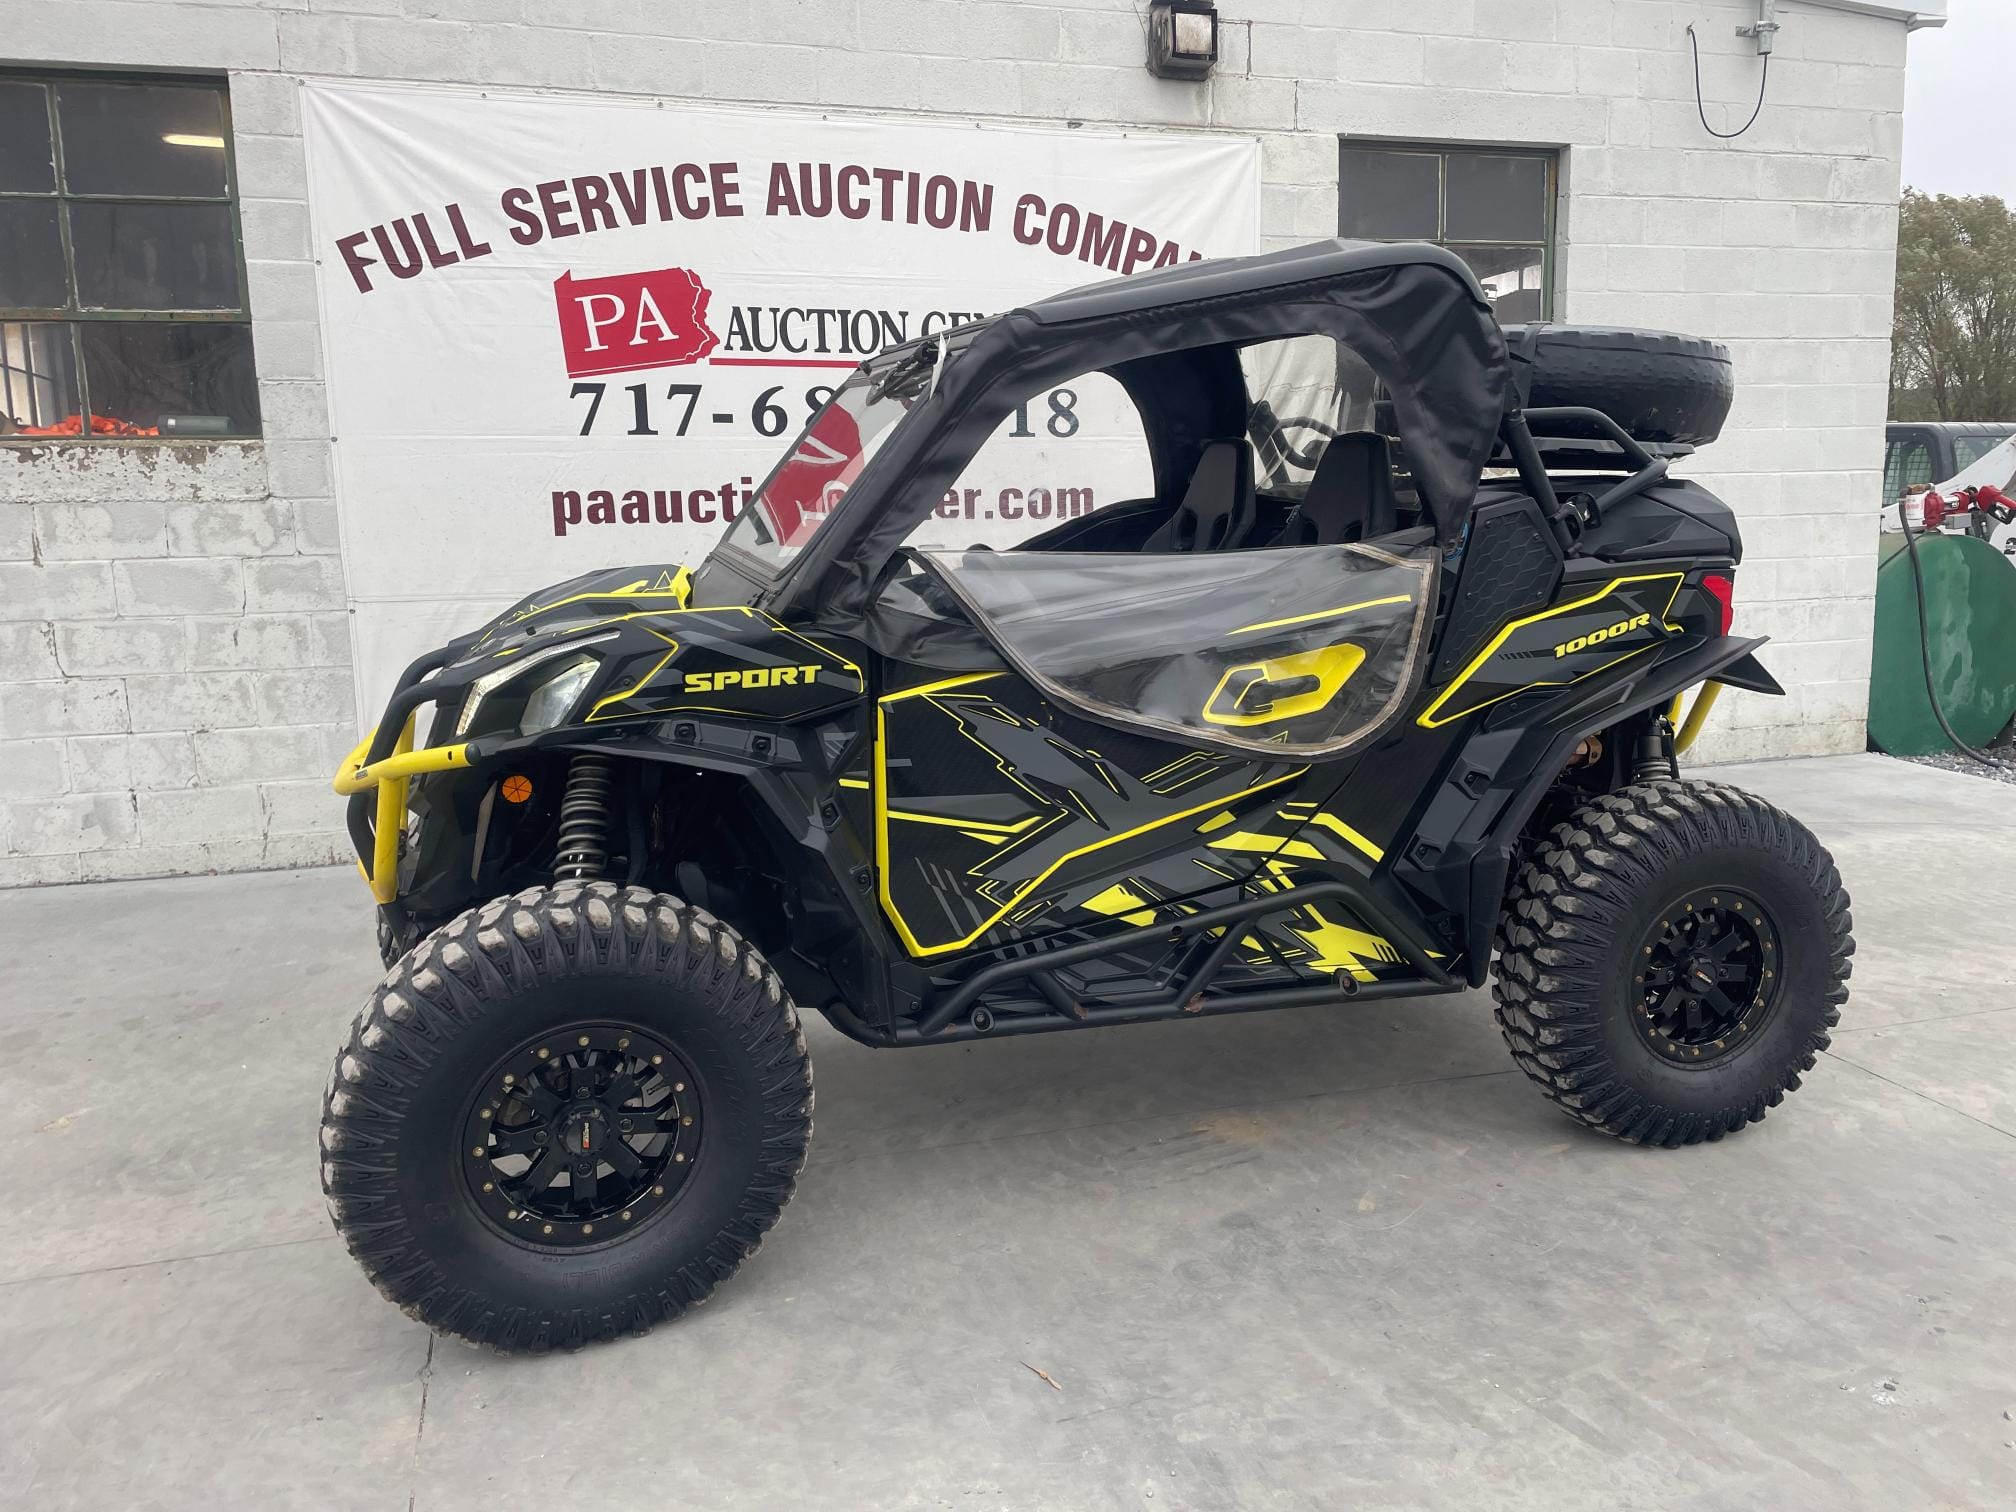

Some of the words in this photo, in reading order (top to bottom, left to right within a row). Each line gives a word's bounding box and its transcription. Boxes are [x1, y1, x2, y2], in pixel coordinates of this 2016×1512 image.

[335, 203, 492, 294] FULL
[501, 162, 744, 246] SERVICE
[766, 162, 994, 233] AUCTION
[1013, 194, 1203, 275] COMPA
[574, 287, 679, 352] PA
[724, 306, 908, 353] AUCTION
[1554, 612, 1651, 659] 1000R
[684, 665, 822, 693] SPORT
